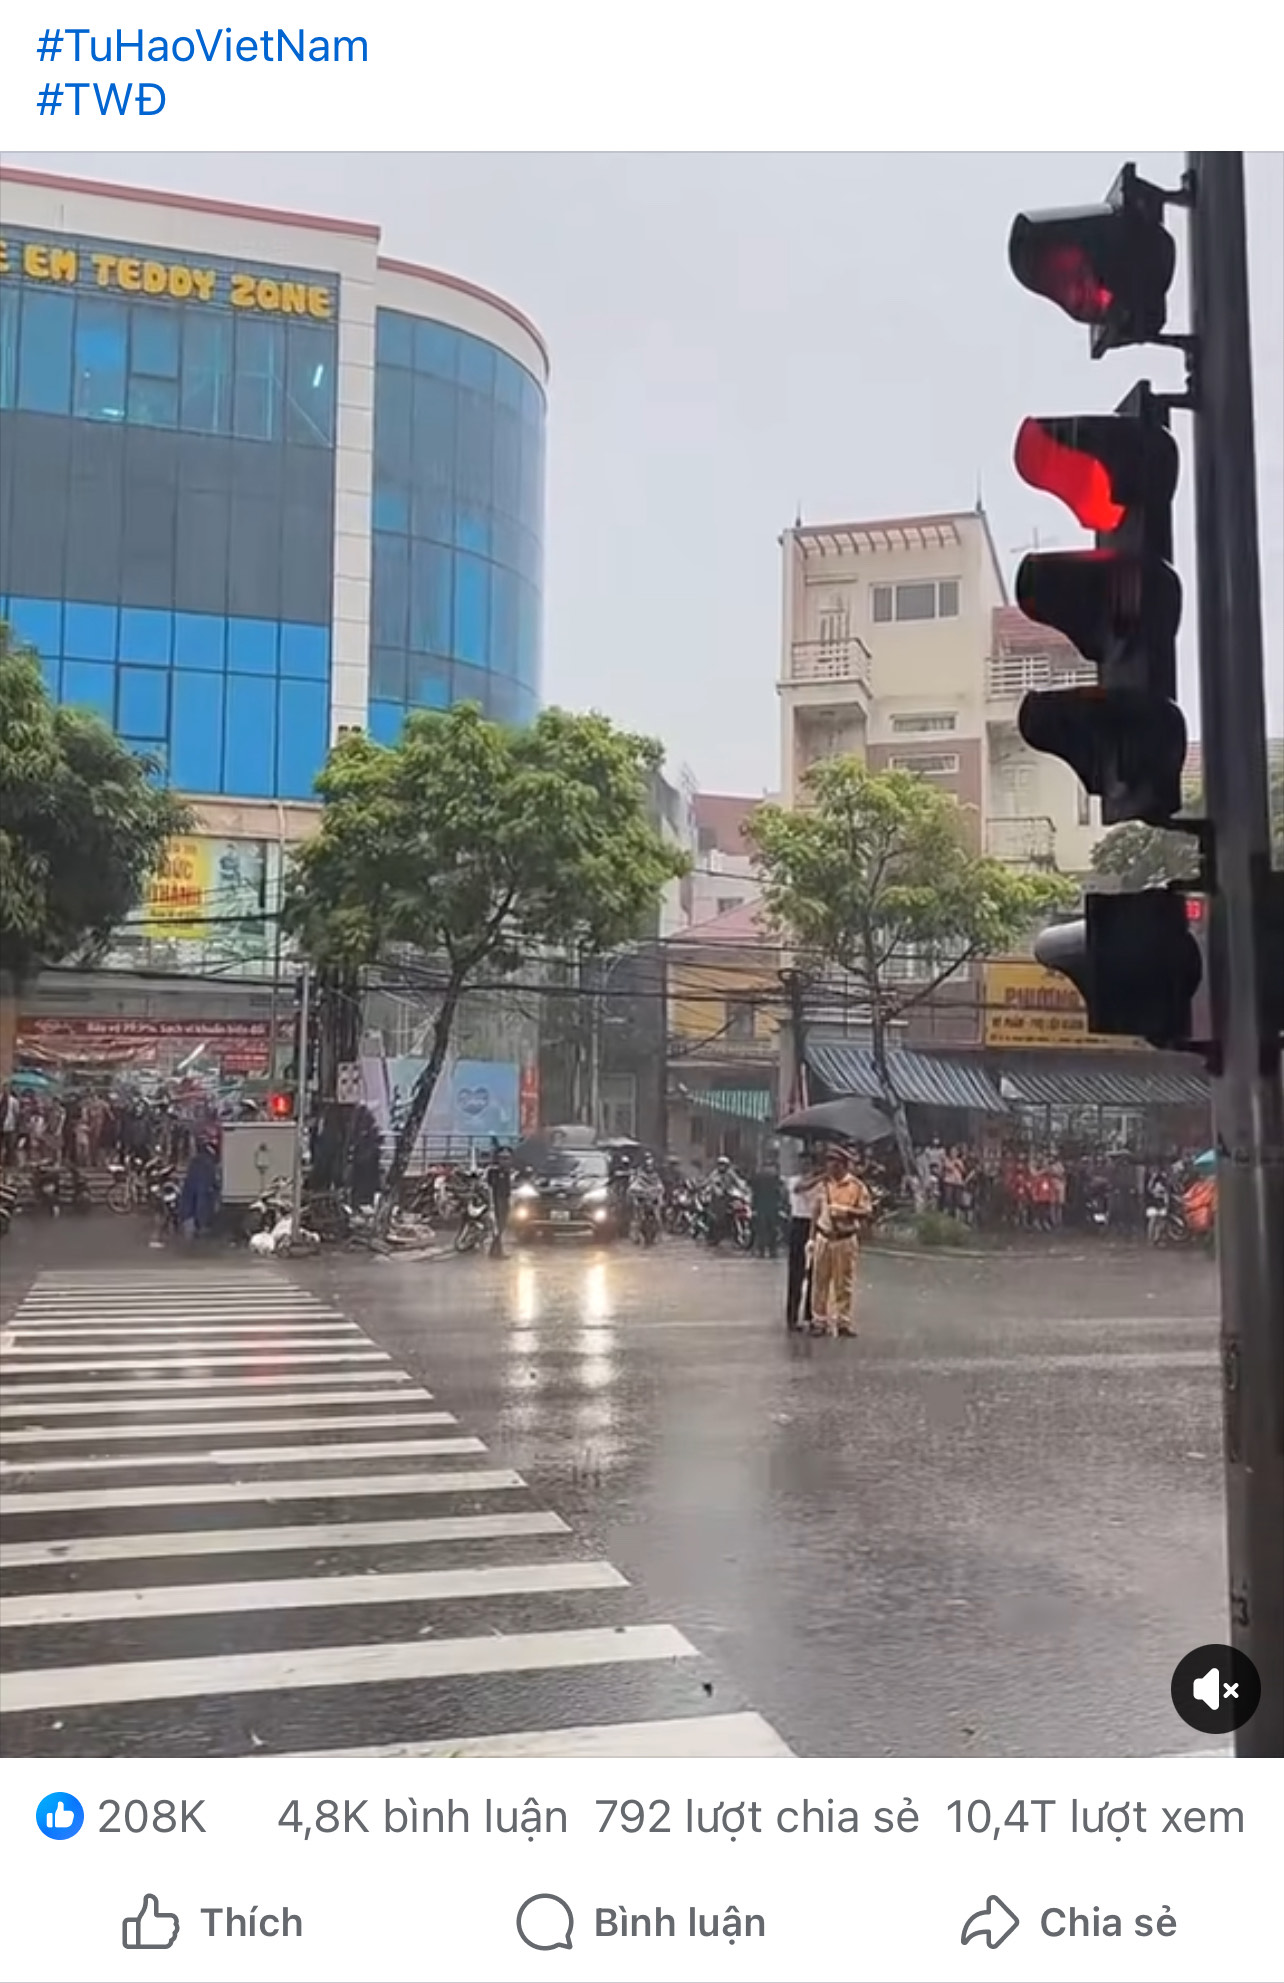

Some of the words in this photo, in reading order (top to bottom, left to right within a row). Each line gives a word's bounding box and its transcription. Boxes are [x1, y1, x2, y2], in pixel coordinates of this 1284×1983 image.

[24, 244, 77, 283] EM
[92, 253, 217, 301] TEDDY
[230, 273, 333, 318] ZONE
